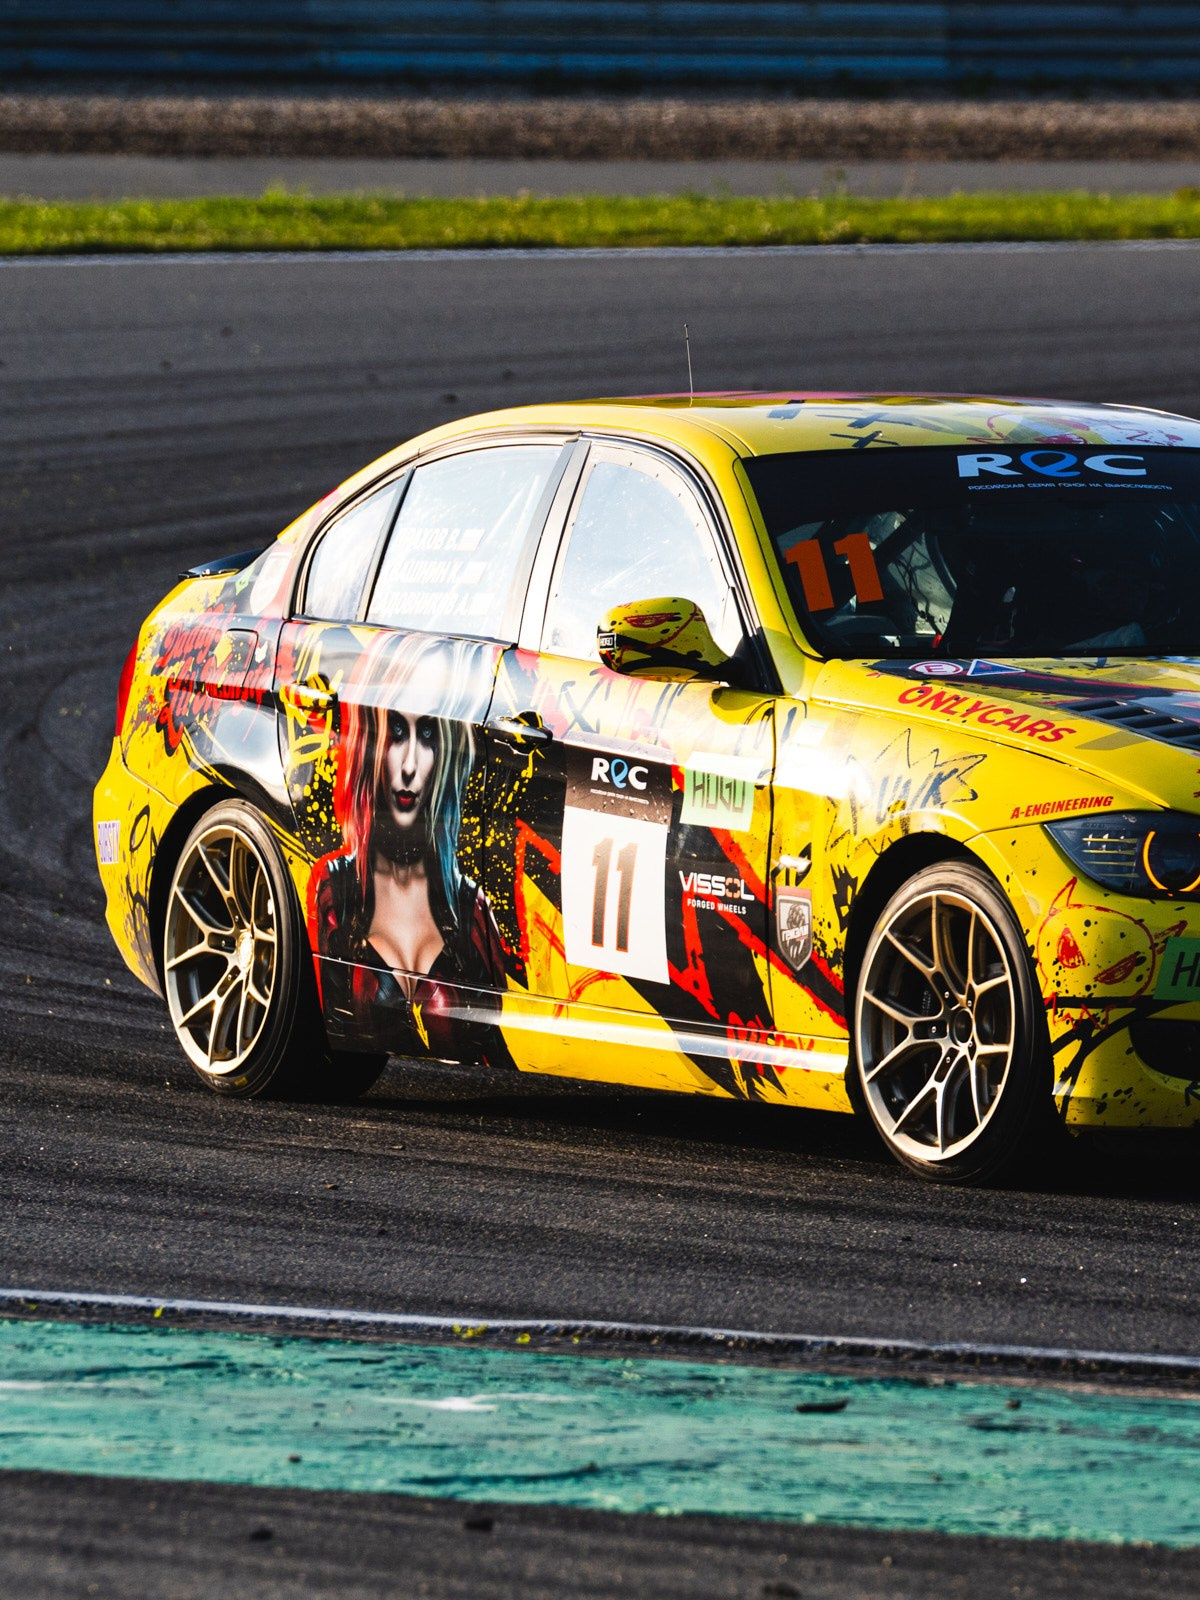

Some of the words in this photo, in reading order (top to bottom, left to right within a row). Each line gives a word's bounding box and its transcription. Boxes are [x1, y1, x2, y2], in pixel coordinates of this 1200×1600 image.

[784, 532, 884, 612] 11
[924, 664, 948, 673] E
[897, 686, 1077, 742] ONLYCARS
[1010, 796, 1114, 820] A-ENGINEERING
[591, 837, 639, 953] 11
[679, 870, 755, 901] VISSOL
[686, 898, 715, 911] FORGED
[717, 902, 747, 915] WHEELS
